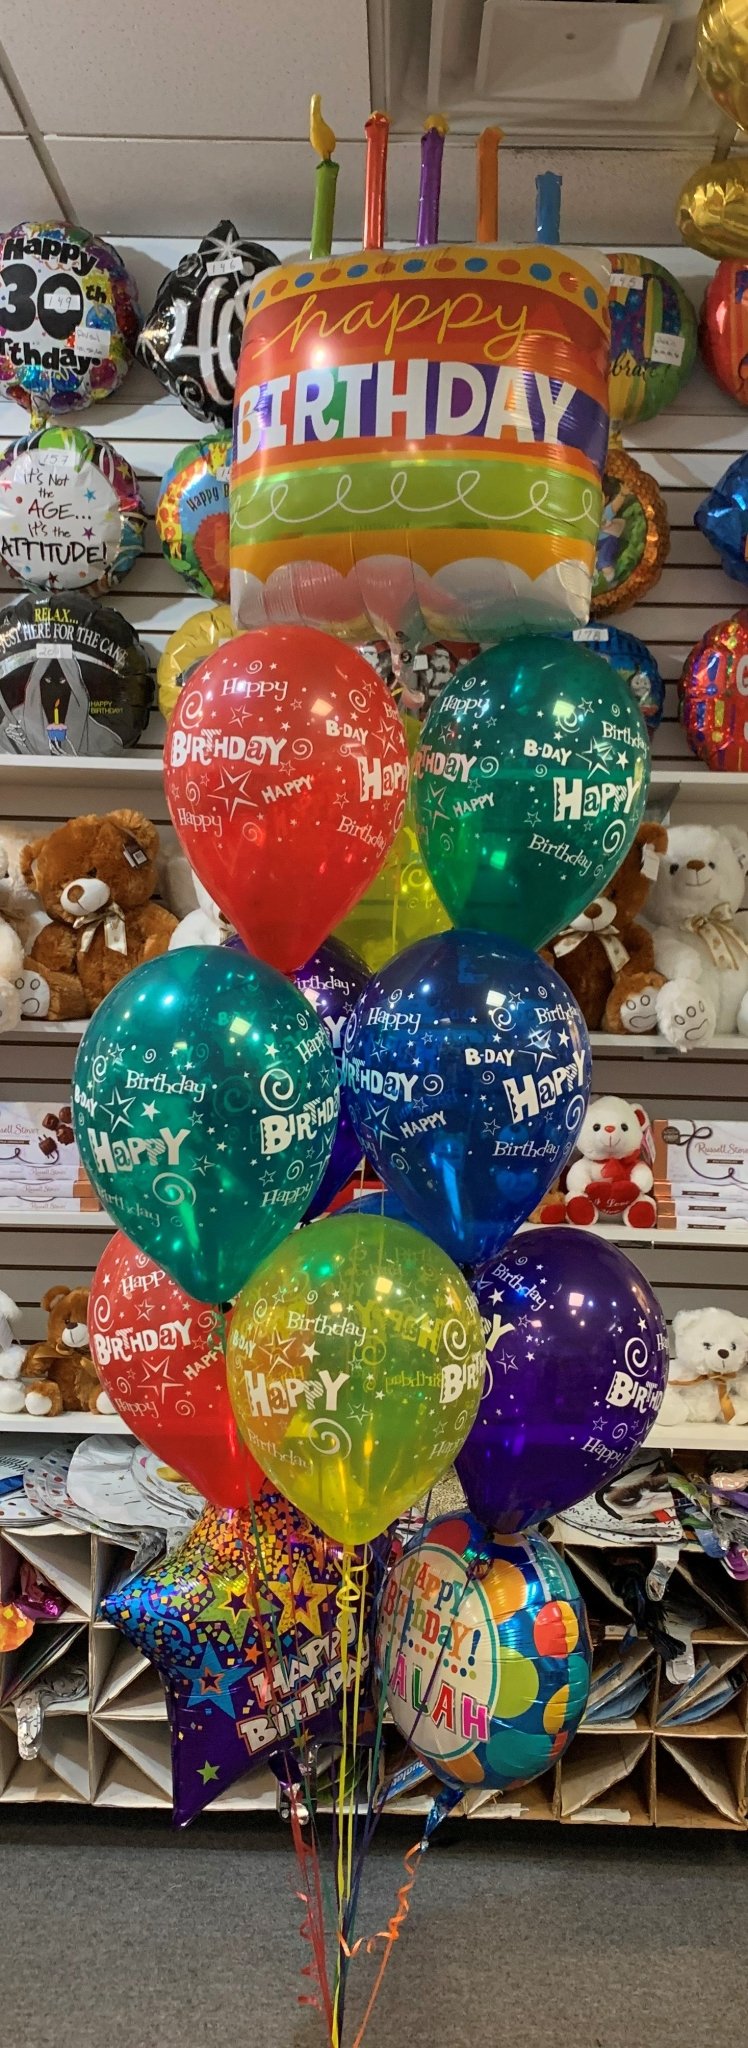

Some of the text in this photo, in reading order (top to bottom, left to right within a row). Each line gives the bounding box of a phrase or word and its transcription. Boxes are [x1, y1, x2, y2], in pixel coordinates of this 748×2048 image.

[3, 237, 99, 277] Happy
[251, 293, 574, 362] happy
[236, 357, 578, 464] BIRTHDAY
[38, 487, 55, 498] the
[186, 488, 219, 512] Happy
[52, 526, 72, 538] the
[0, 535, 107, 566] ATTITUDE!
[34, 606, 79, 624] RELAX...
[22, 622, 51, 641] HERE
[53, 622, 74, 641] FOR
[76, 626, 101, 649] THE
[440, 695, 491, 718] Happy
[325, 720, 369, 745] B-DAY
[524, 739, 572, 767] B-DAY
[261, 774, 315, 804] HAPPY
[453, 792, 495, 818] HAPPY
[178, 808, 222, 837] Happy
[528, 834, 593, 877] Birthday
[294, 976, 350, 996] irthday
[367, 1007, 421, 1034] Happy
[464, 1048, 515, 1067] B-DAY
[125, 1069, 206, 1102] Birthday
[400, 1111, 447, 1139] HAPPY
[492, 1141, 560, 1162] Birthday
[695, 1143, 748, 1156] Russell Stove
[262, 1180, 313, 1208] Happy
[121, 1270, 166, 1298] Happ
[490, 1263, 547, 1312] Birthday
[287, 1311, 367, 1346] Birthday
